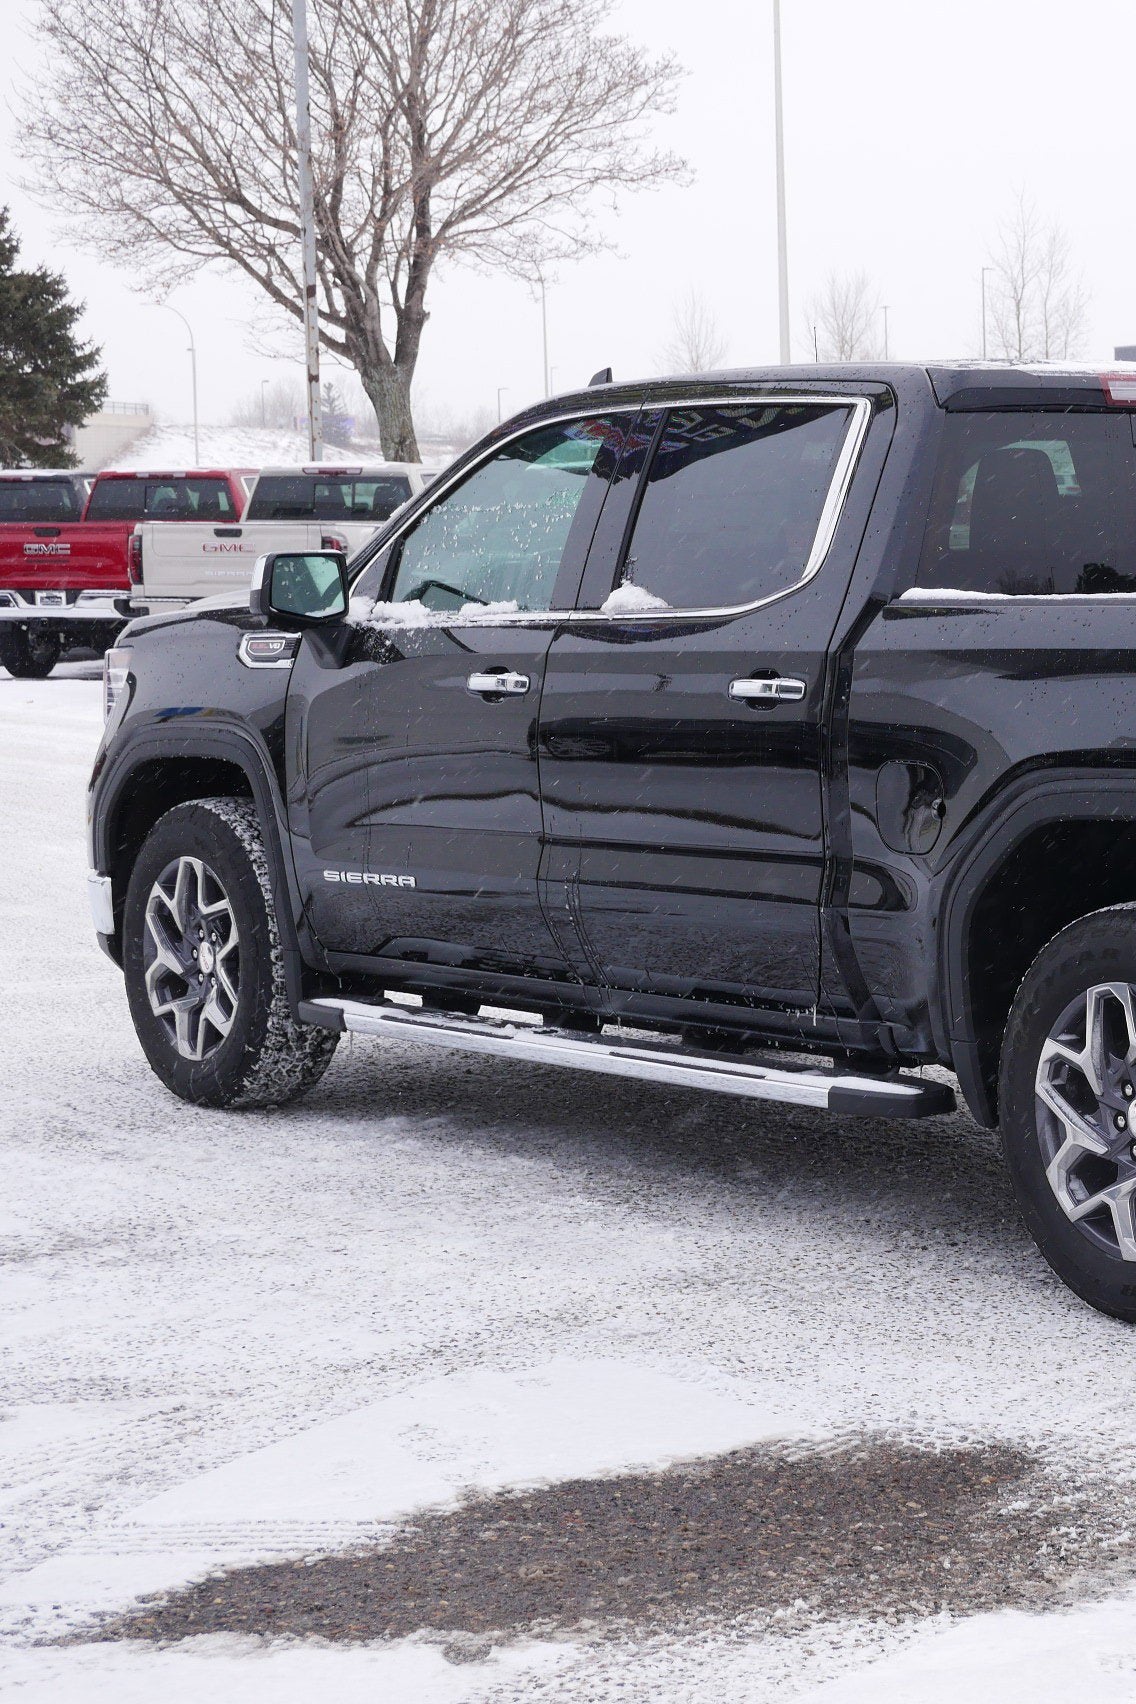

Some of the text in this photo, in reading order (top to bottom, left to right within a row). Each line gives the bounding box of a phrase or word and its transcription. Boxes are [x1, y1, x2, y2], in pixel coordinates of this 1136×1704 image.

[24, 543, 71, 555] GMC
[202, 542, 255, 552] GMC
[323, 869, 416, 888] SIERRA
